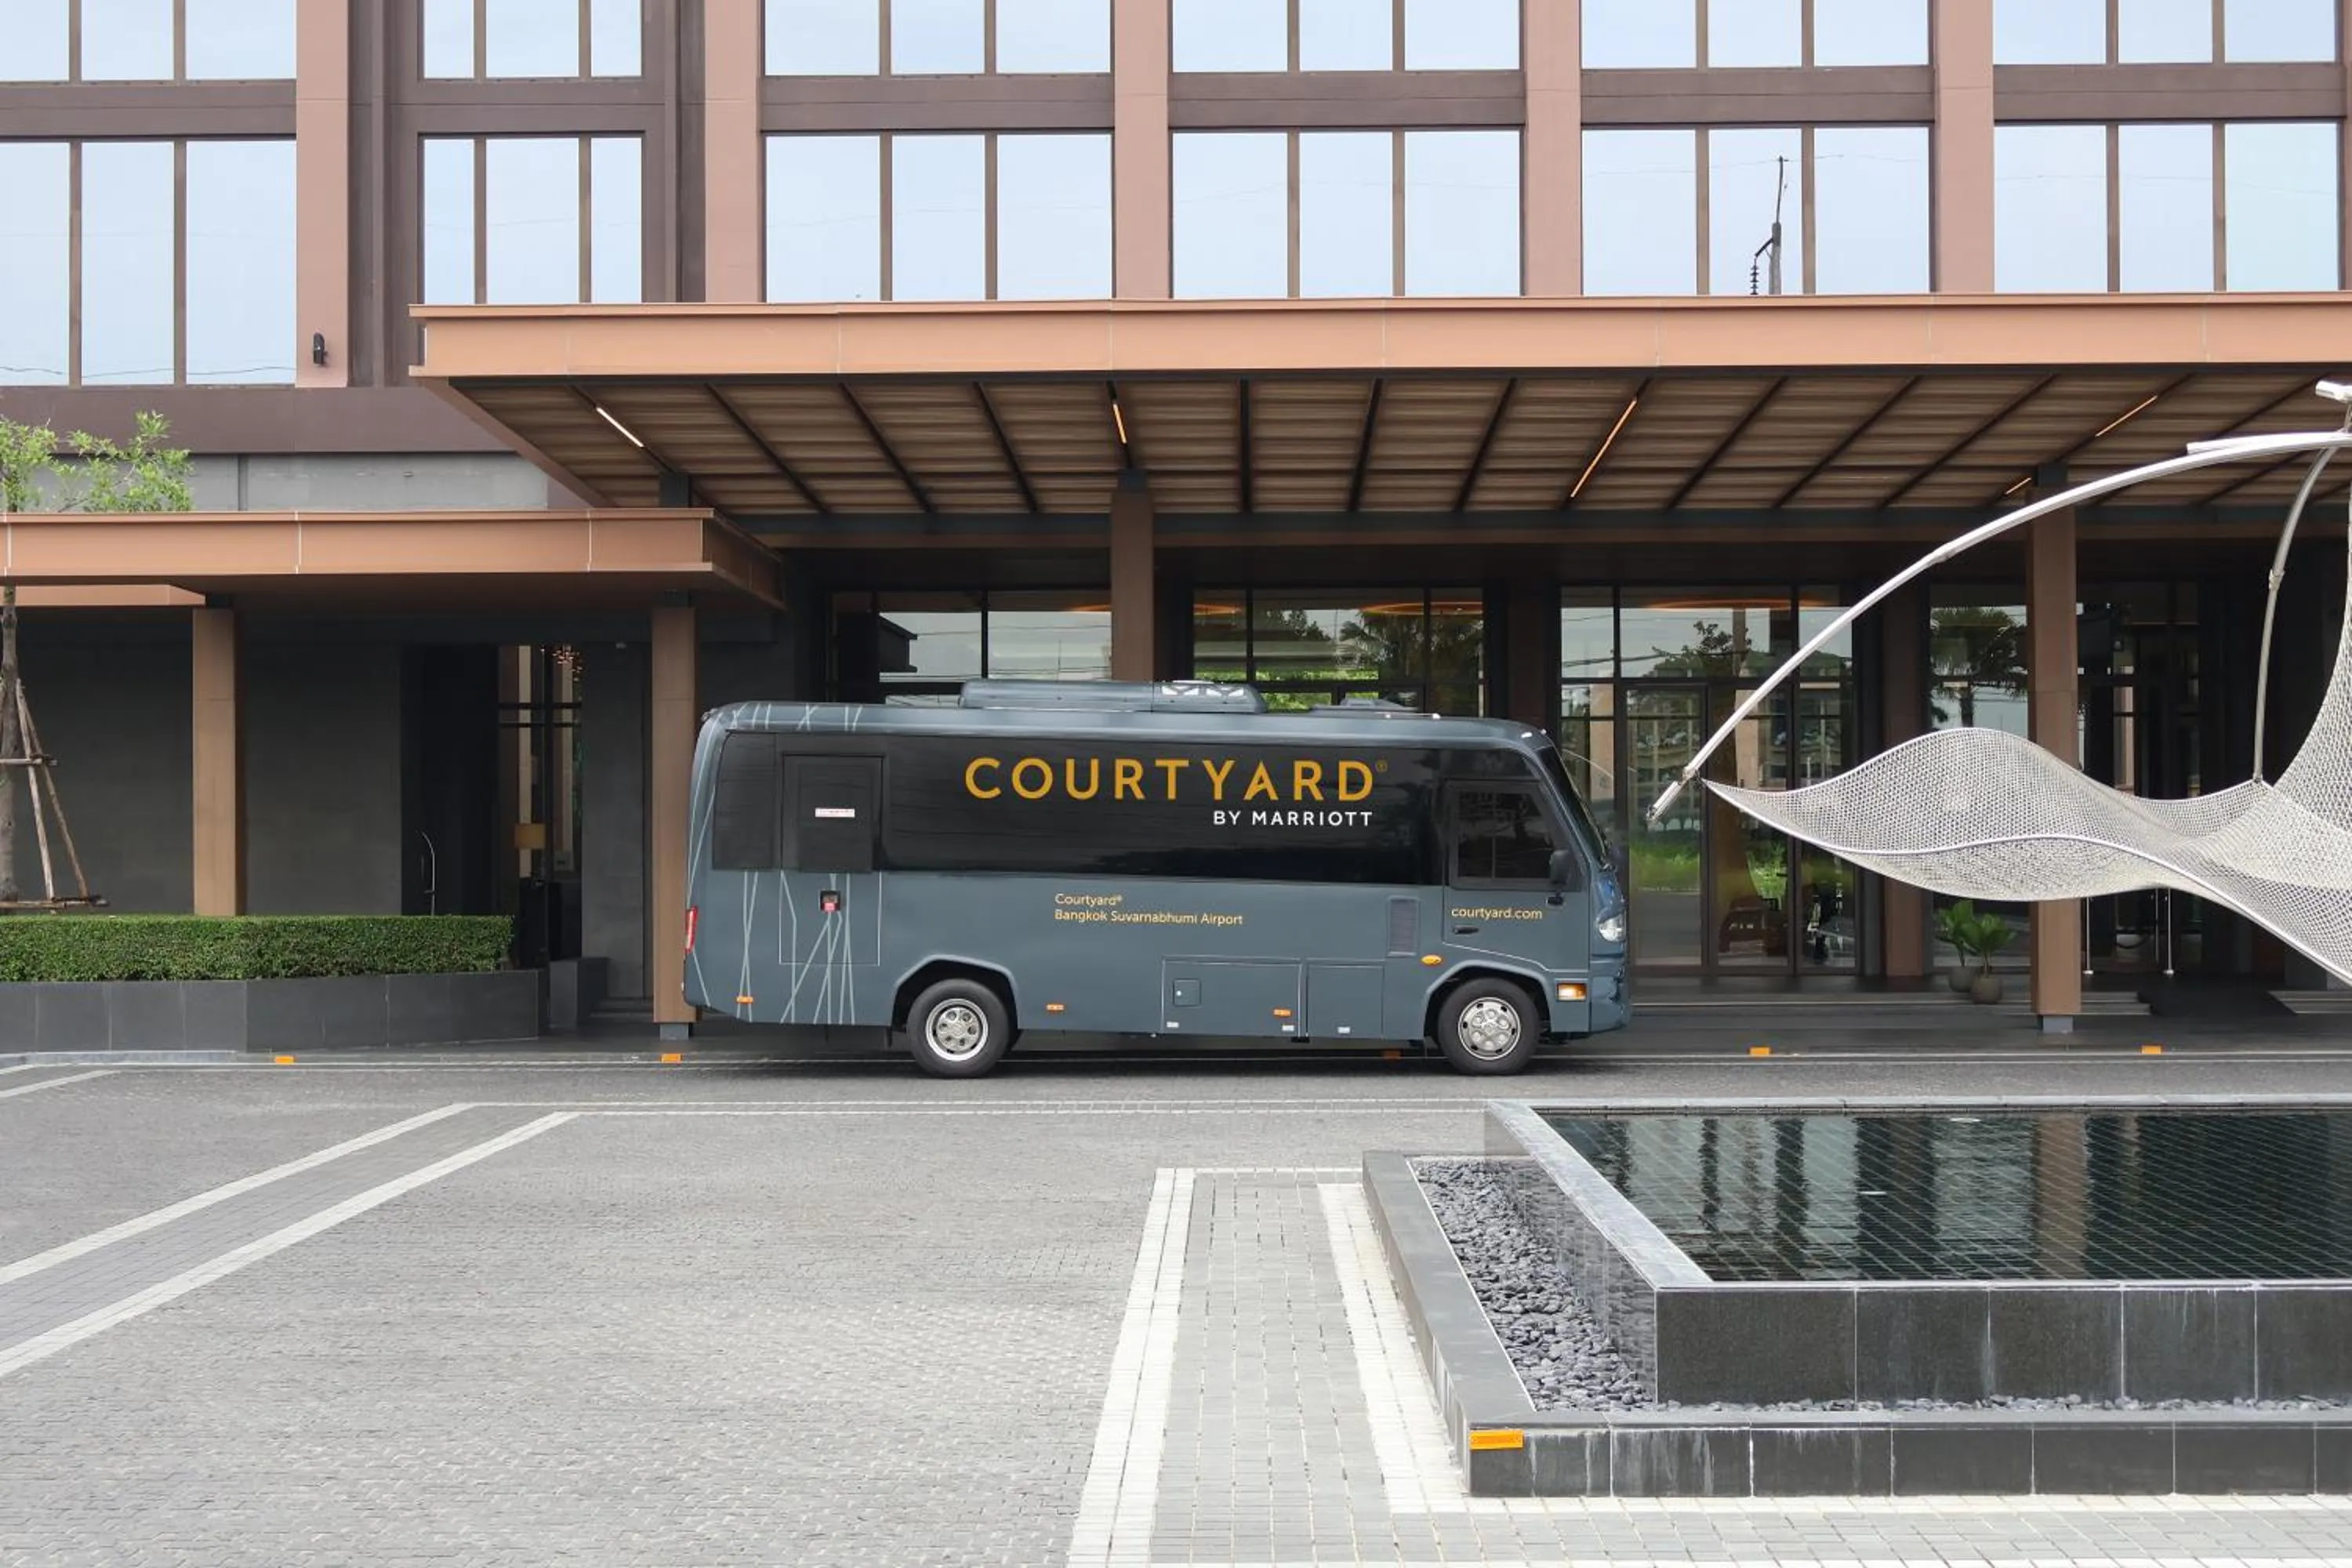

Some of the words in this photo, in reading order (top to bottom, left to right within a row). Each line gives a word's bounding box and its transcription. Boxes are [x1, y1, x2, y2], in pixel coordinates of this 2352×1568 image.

[1213, 810, 1241, 826] BY
[1251, 810, 1373, 826] MARRIOTT
[1054, 909, 1108, 923] Bangkok
[1111, 910, 1198, 924] Suvarnabhumi
[1200, 913, 1243, 927] Airport
[1451, 907, 1543, 920] courtyard.com
